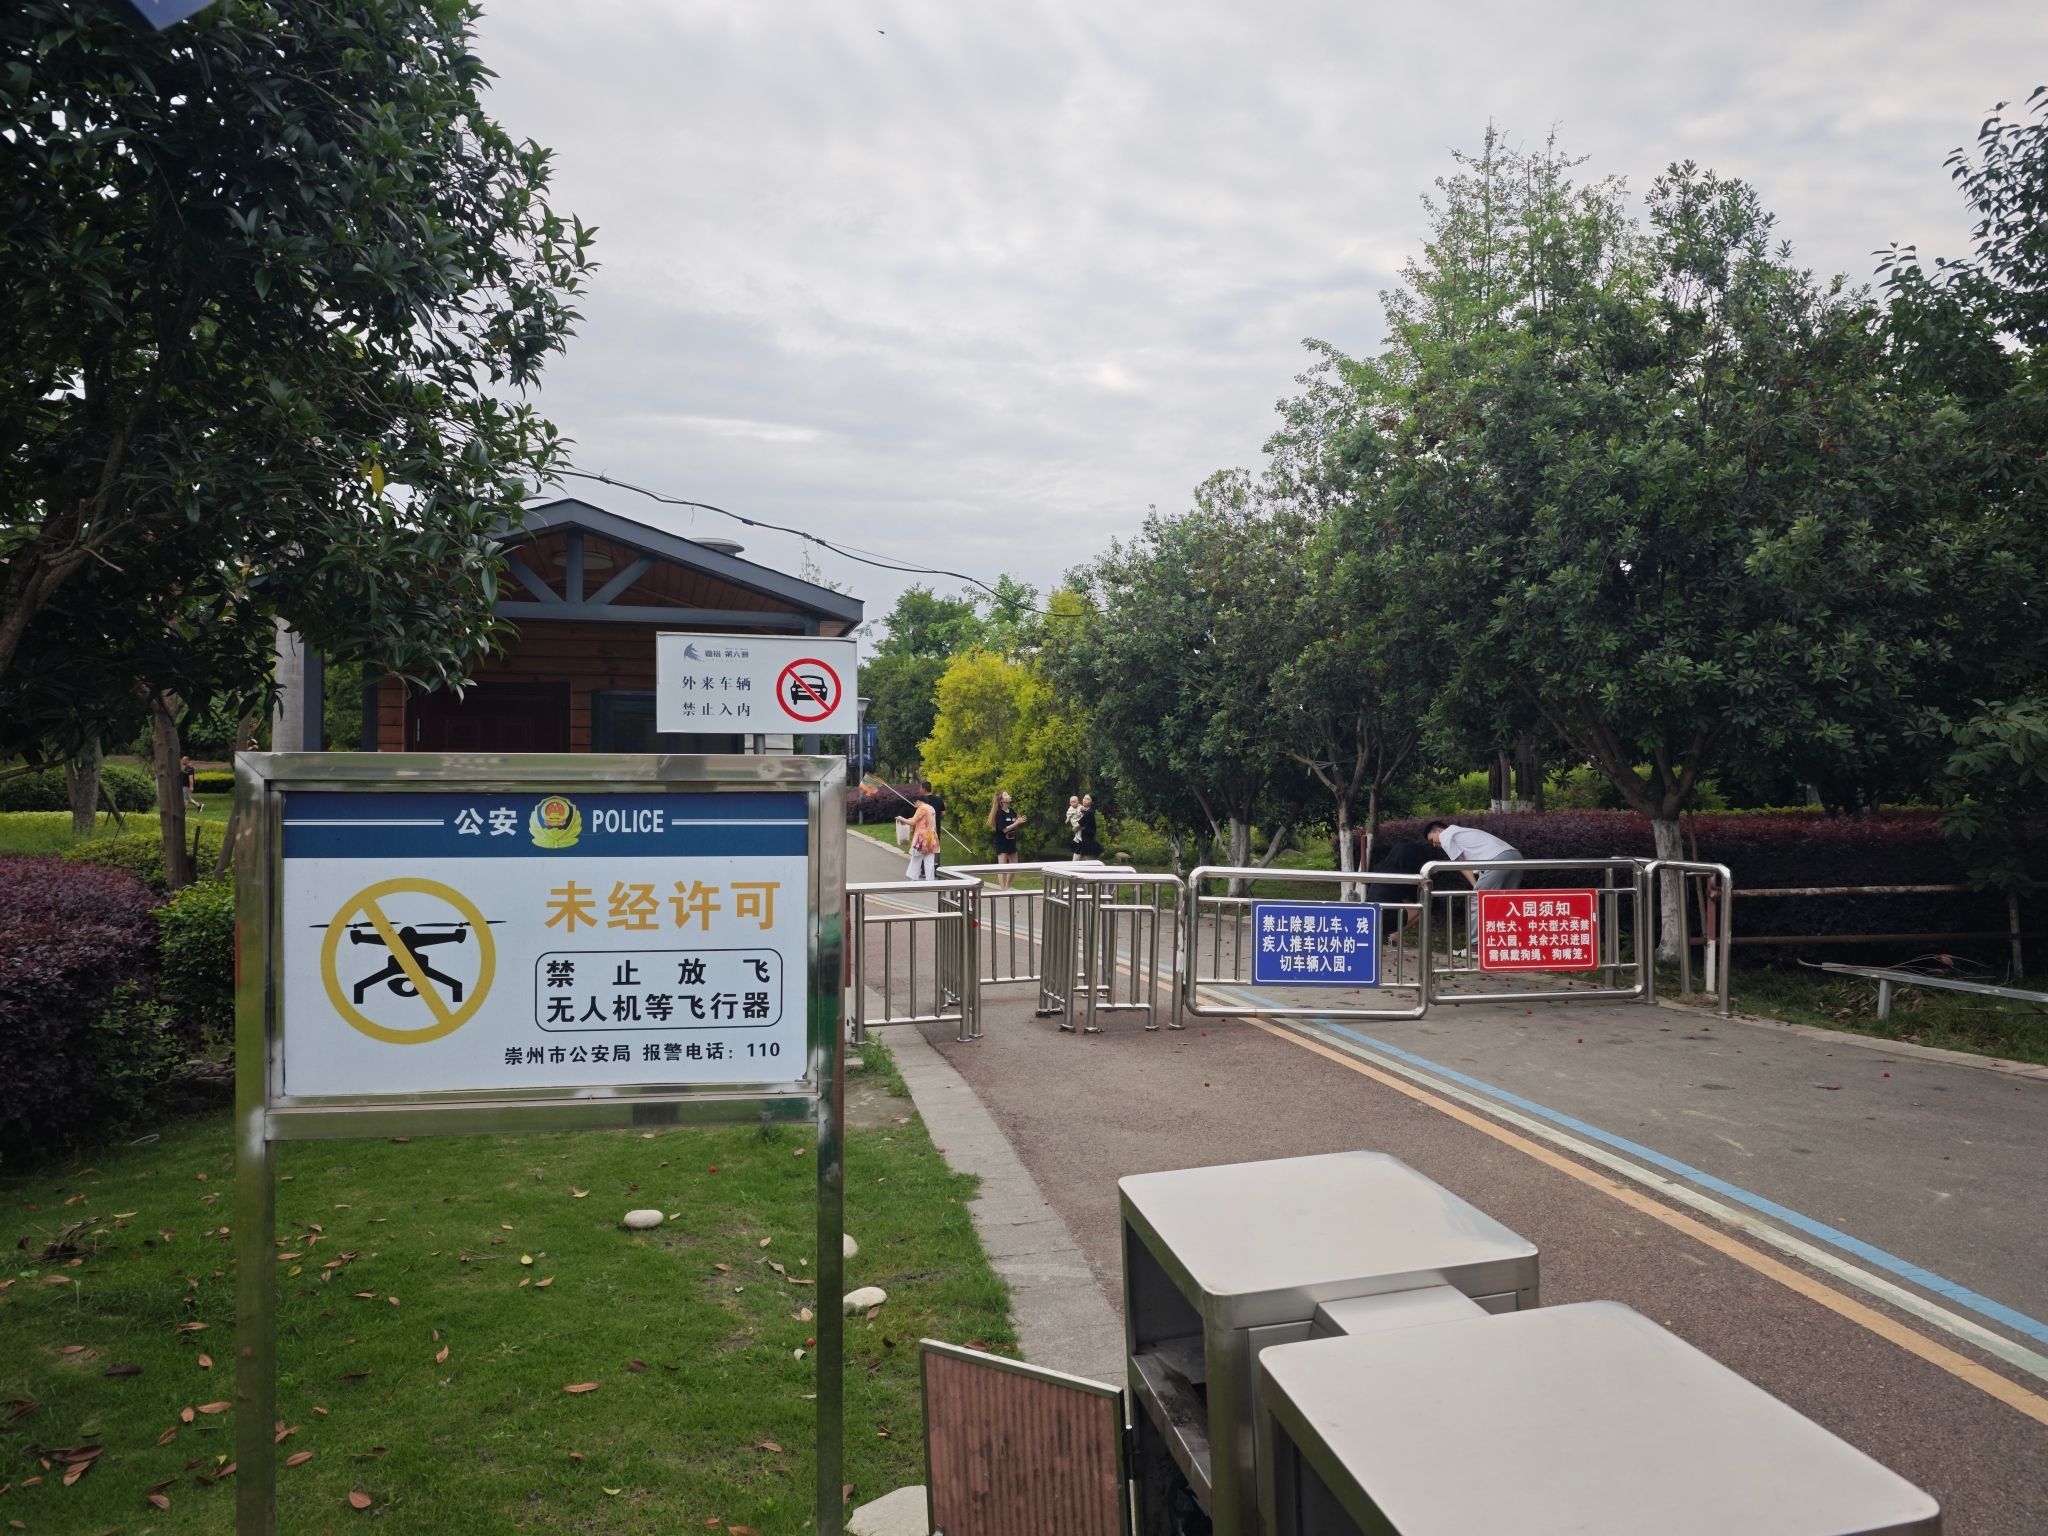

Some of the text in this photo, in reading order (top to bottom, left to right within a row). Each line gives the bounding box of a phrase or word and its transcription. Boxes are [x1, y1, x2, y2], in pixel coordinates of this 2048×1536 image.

[682, 676, 752, 691] 外来车辆
[682, 702, 751, 717] 禁止入内
[453, 808, 665, 836] 公安 POLICE
[544, 880, 782, 933] 未经许可
[1506, 901, 1571, 917] 入园须知
[1262, 914, 1369, 934] 禁止除婴儿车、残
[1486, 919, 1590, 933] 烈性犬、中大型犬类禁
[1262, 935, 1369, 954] 疾人推车以外的一
[546, 957, 771, 988] 禁止放飞
[1279, 955, 1352, 972] 切车辆入园。
[546, 992, 771, 1024] 无人机等飞行器
[504, 1044, 632, 1066] 崇州市公安局
